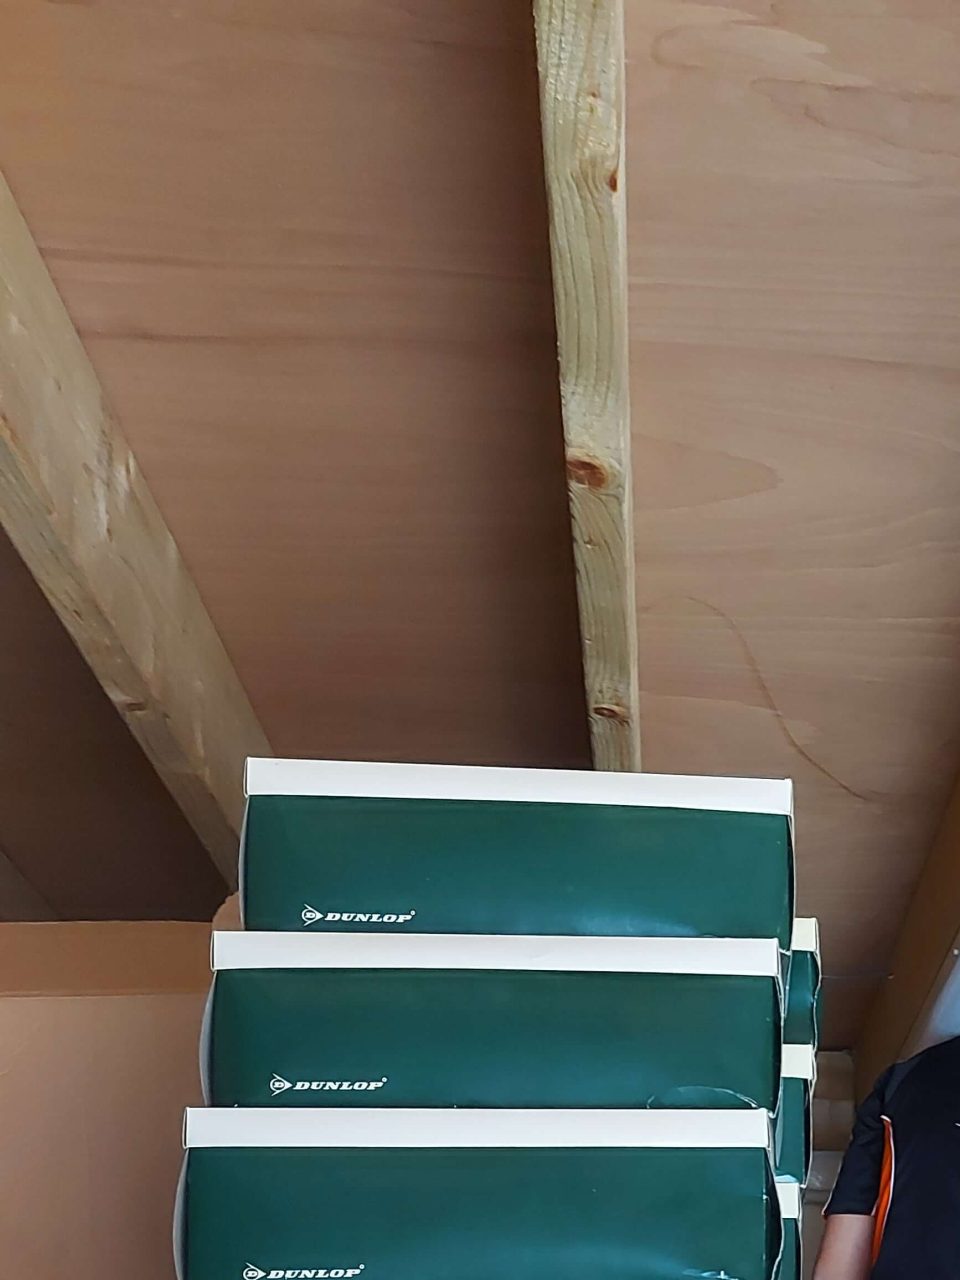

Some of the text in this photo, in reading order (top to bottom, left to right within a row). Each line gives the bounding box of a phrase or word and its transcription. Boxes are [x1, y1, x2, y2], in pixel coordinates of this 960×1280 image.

[324, 912, 412, 923] DUNLOP
[292, 1081, 384, 1090] DUNLOP
[266, 1268, 361, 1279] DUNLOP
